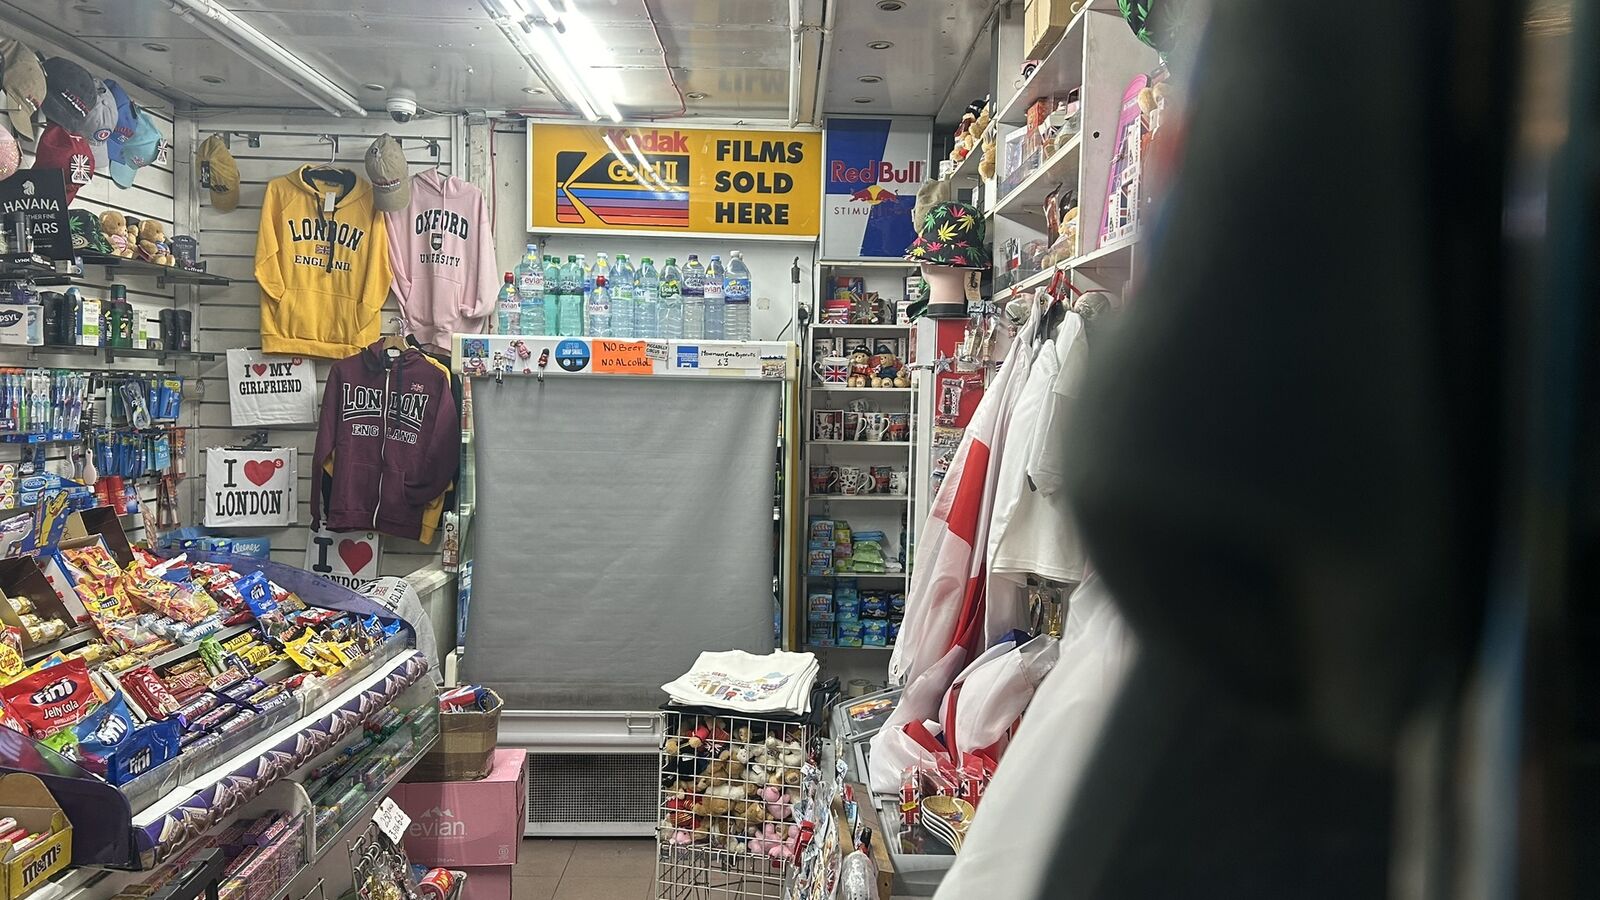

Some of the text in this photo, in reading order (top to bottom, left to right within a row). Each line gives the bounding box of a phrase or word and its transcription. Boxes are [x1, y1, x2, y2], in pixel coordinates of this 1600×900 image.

[716, 139, 804, 163] FILMS
[714, 171, 794, 193] SOLD
[831, 160, 921, 183] Red Bull
[4, 198, 59, 213] HAVANA
[715, 202, 789, 225] HERE
[288, 218, 364, 252] LONDON
[415, 209, 470, 241] OXFORD
[244, 363, 292, 378] I MY
[601, 359, 613, 367] NO
[239, 379, 302, 396] GIRLFRIEND
[223, 459, 237, 487] I
[215, 490, 283, 516] LONDON
[313, 536, 333, 573] I
[33, 678, 73, 705] Fini
[44, 700, 79, 719] Jelly Cola
[130, 747, 150, 774] Fini
[410, 819, 465, 836] evian
